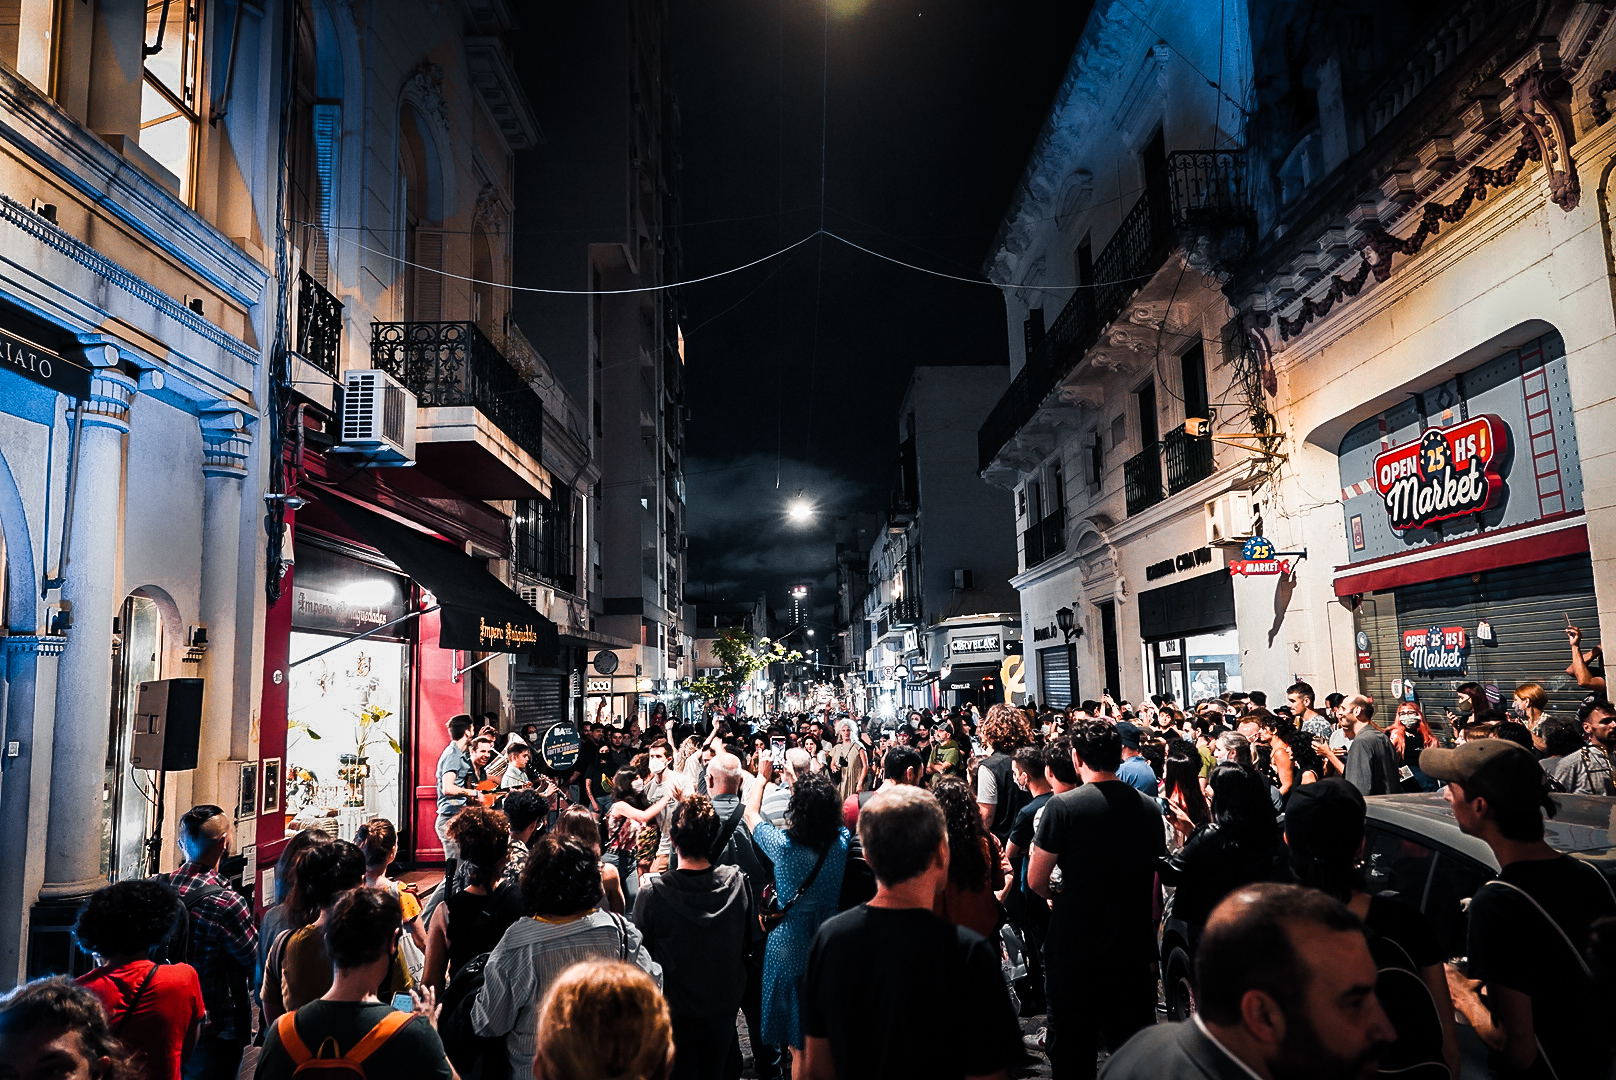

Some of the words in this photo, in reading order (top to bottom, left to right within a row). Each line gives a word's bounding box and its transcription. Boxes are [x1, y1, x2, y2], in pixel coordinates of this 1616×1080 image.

[0, 340, 52, 378] IATO
[1380, 455, 1417, 486] OPEN
[1427, 446, 1445, 473] 25
[1387, 458, 1482, 521] Market
[1252, 546, 1269, 559] 25
[1245, 561, 1279, 573] MARKET
[1405, 634, 1427, 648] OPEN
[1431, 634, 1441, 647] 25
[1410, 645, 1461, 670] Market
